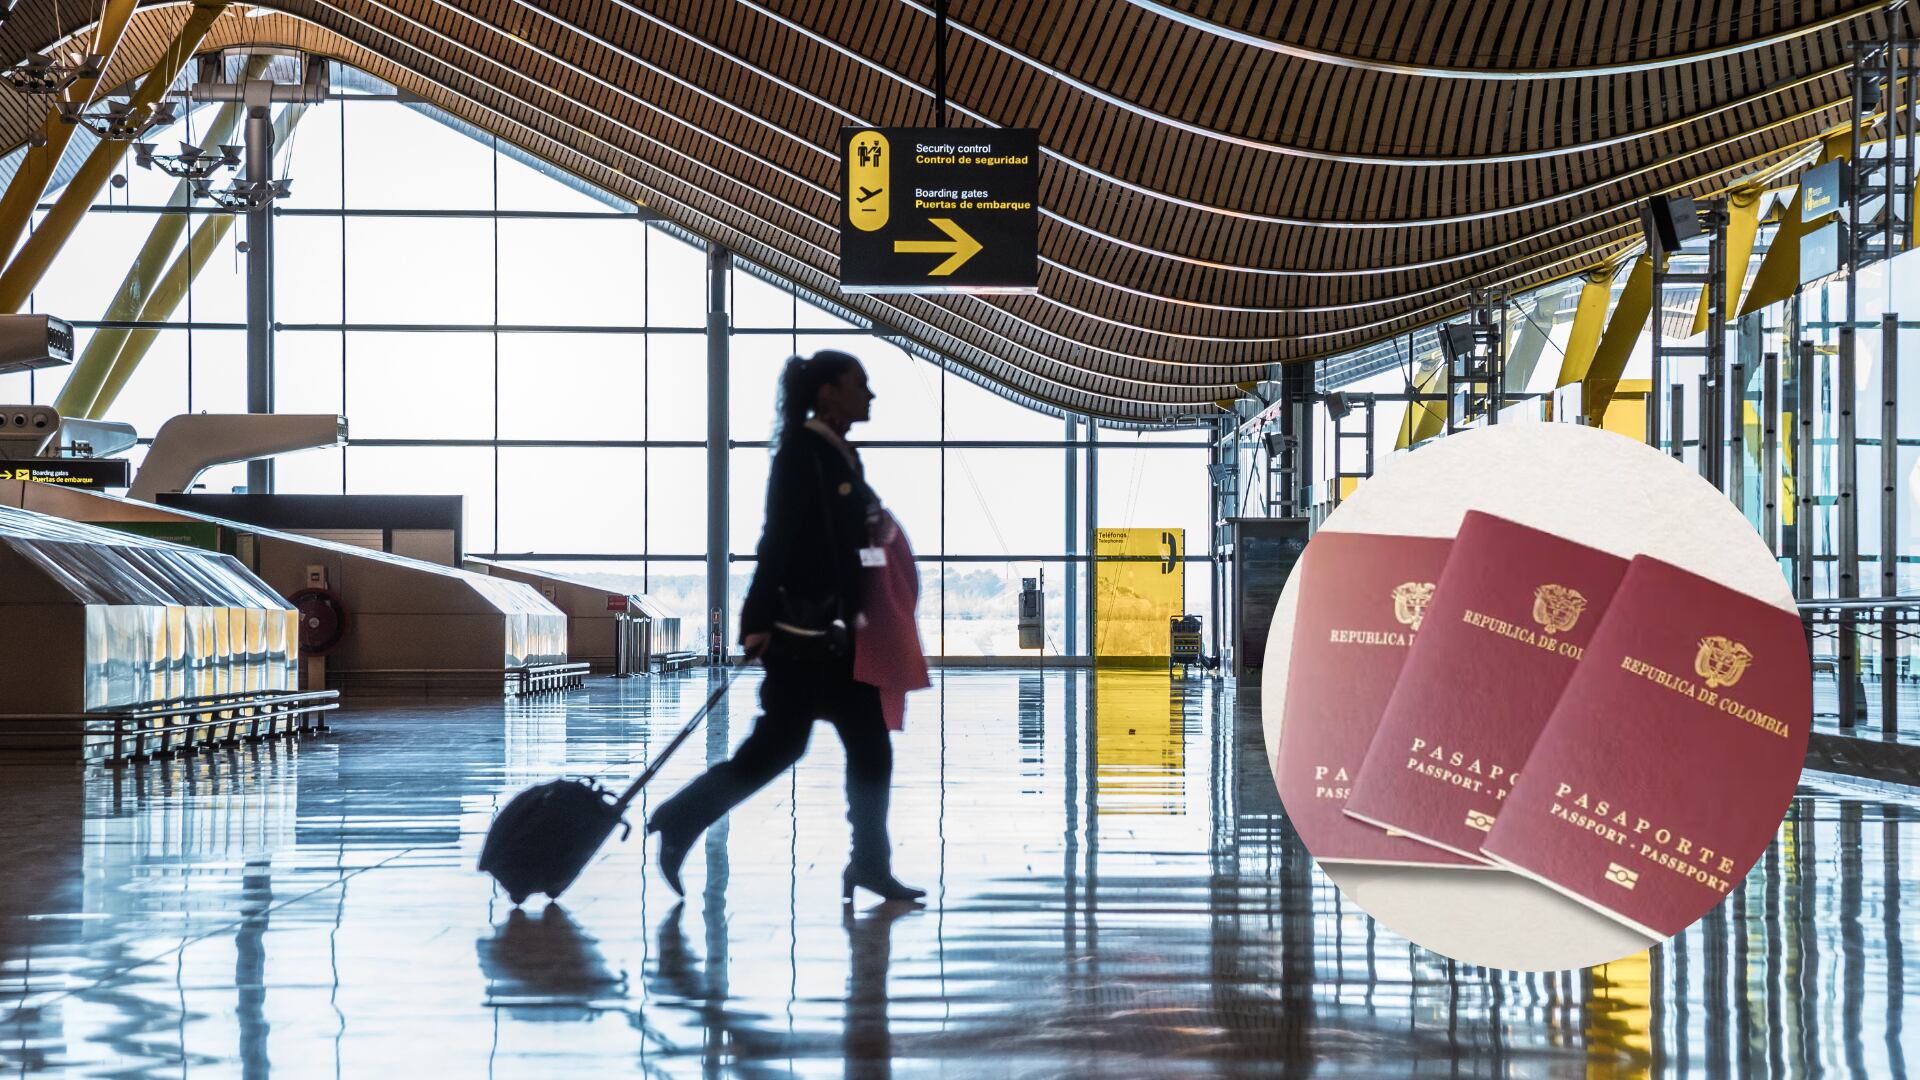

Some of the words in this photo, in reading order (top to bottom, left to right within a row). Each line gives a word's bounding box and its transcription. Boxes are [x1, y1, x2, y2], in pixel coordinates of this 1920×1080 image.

[916, 143, 955, 154] Security
[957, 143, 991, 153] control
[915, 155, 955, 164] Control
[958, 155, 972, 164] de
[975, 155, 1029, 166] seguridad
[915, 188, 958, 199] Boarding
[961, 188, 989, 199] gates
[915, 199, 957, 209] Puertas
[959, 200, 973, 209] de
[976, 200, 1031, 211] embarque
[64, 476, 93, 484] embarque
[1330, 629, 1406, 646] REPUBLICA
[1462, 609, 1536, 645] REPUBLICA
[1537, 634, 1558, 651] DE
[1620, 655, 1696, 698] REPUBLICA
[1697, 687, 1719, 706] DE
[1719, 698, 1790, 738] COLOMBIA
[1406, 757, 1483, 793] PASSPORT
[1555, 782, 1735, 875] PASAPORTE
[1550, 803, 1627, 846] PASSPORT
[1639, 844, 1730, 893] PASSEPORT
